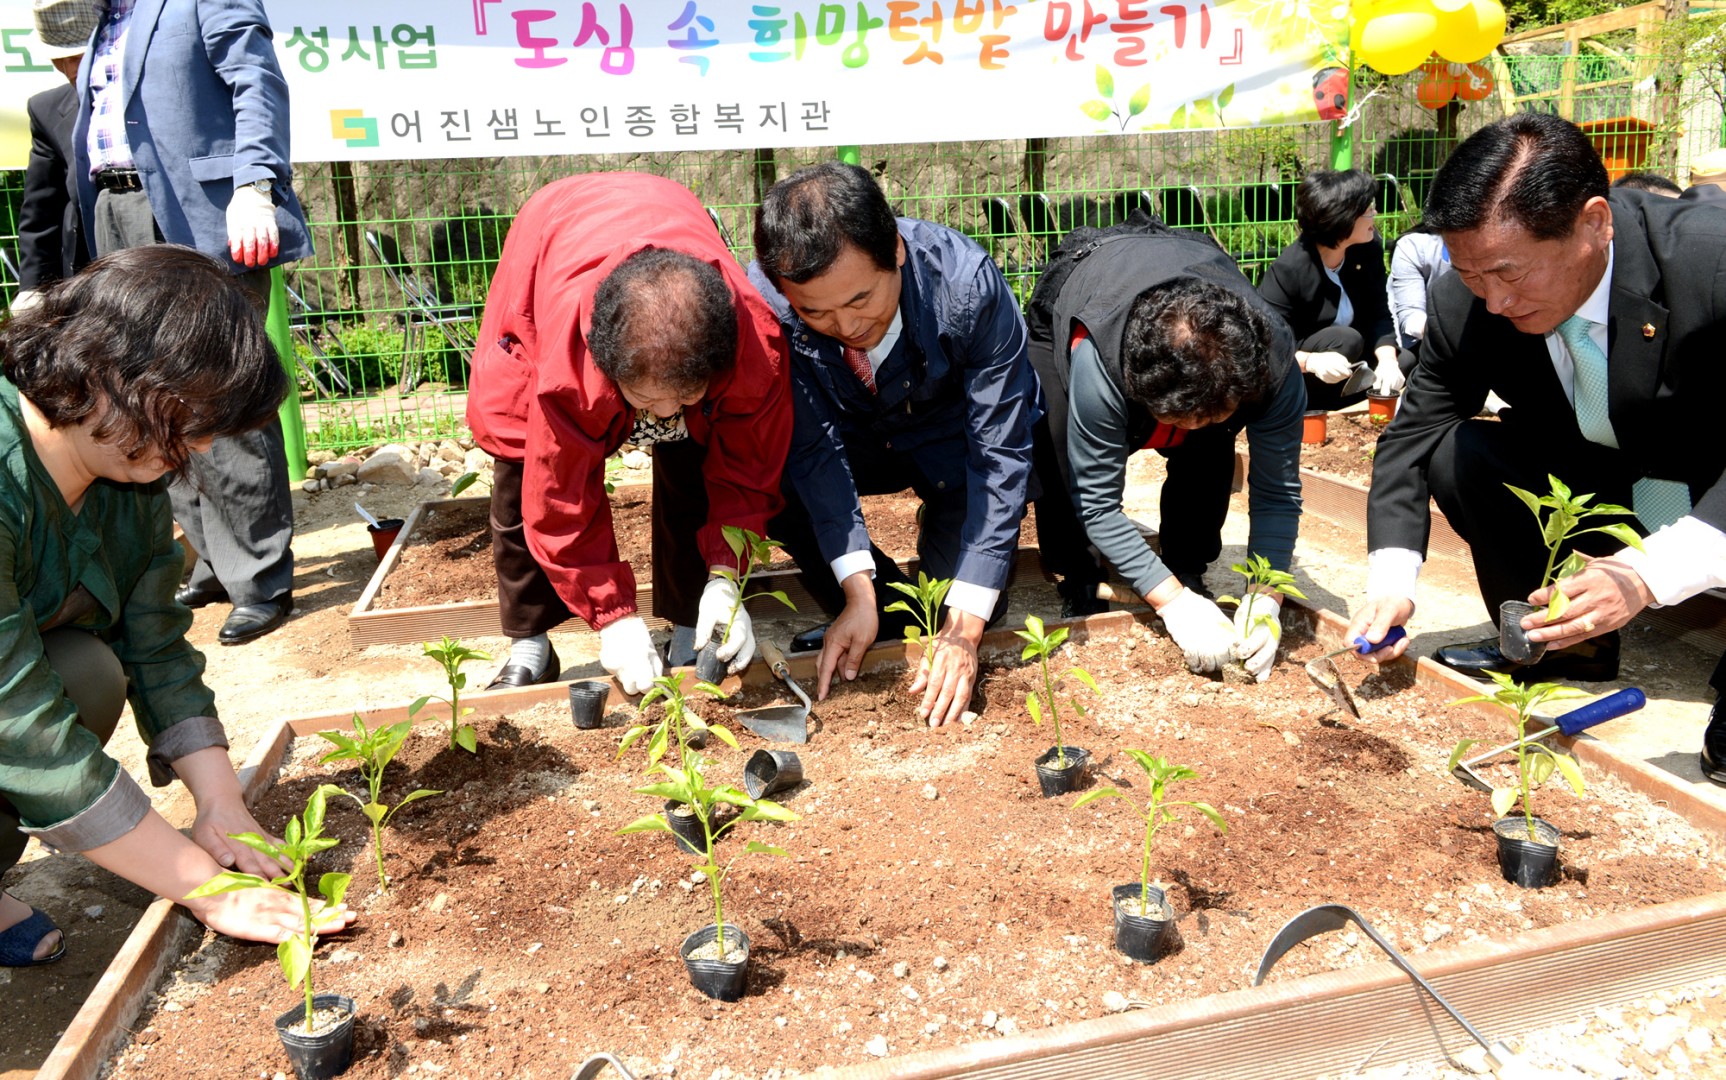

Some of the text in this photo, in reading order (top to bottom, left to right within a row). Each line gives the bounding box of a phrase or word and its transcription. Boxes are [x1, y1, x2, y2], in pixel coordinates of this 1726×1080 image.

[285, 23, 438, 74] 성사업
[667, 0, 720, 76] 속
[747, 0, 1018, 70] 희망텃밭
